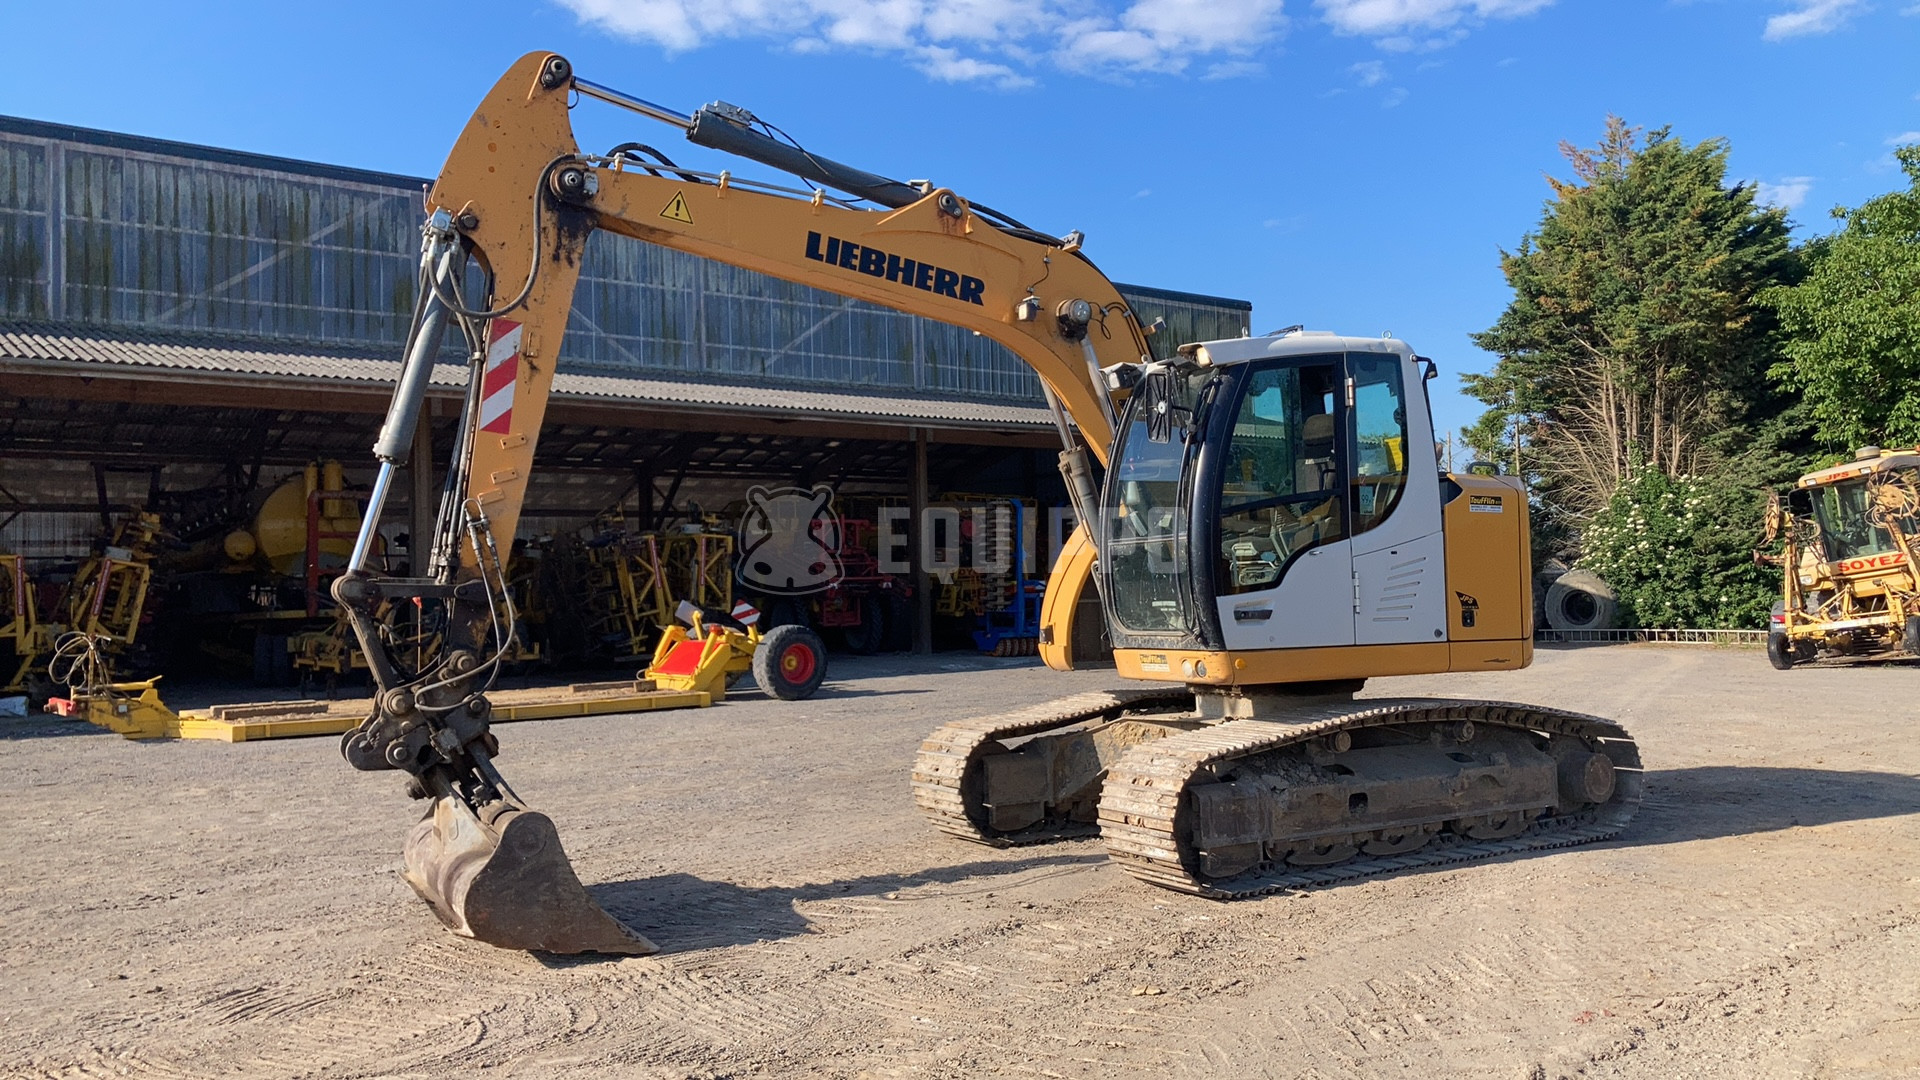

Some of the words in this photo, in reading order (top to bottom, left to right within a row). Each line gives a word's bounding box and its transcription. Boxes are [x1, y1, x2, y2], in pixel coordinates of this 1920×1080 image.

[805, 231, 985, 306] LIEBHERR
[1825, 471, 1849, 481] JPS
[1838, 551, 1906, 572] SOYEZ
[1460, 595, 1474, 604] JPS
